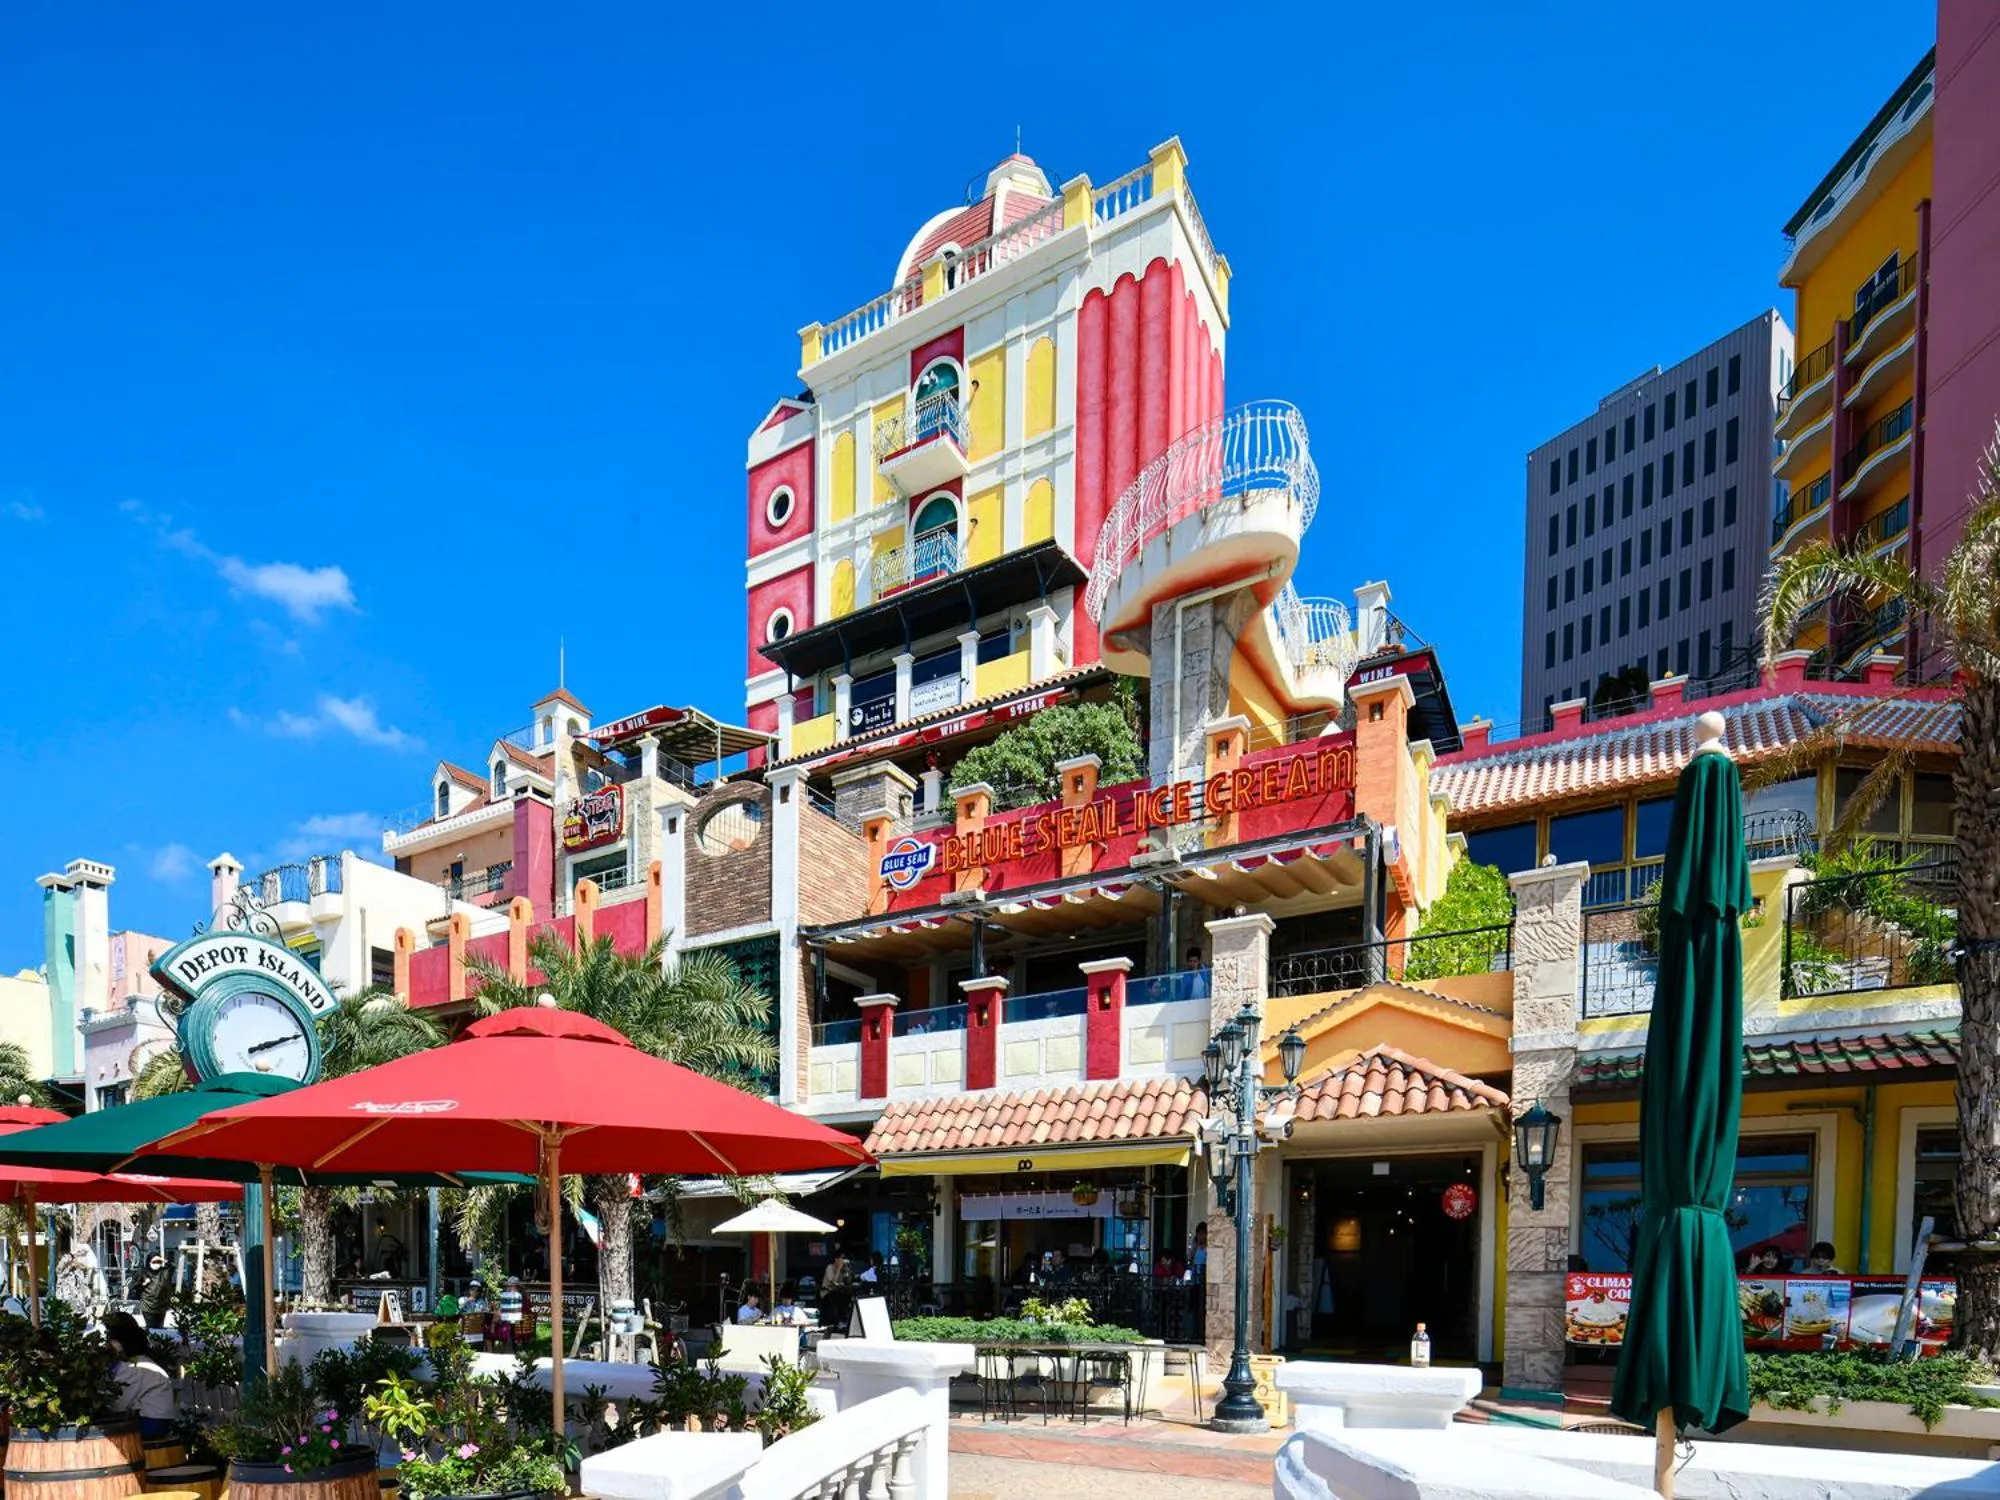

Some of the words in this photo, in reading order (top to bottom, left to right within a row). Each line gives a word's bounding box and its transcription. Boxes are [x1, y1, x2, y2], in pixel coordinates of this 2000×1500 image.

[1360, 666, 1394, 684] WINE
[1010, 697, 1045, 717] STEAK
[627, 714, 650, 730] WINE
[940, 719, 967, 737] WINE
[943, 822, 1025, 872] BLUE
[1036, 799, 1119, 851] SEAL
[1134, 780, 1192, 832] ICE
[1205, 747, 1356, 814] CREAM
[884, 857, 905, 871] BLUE
[906, 851, 927, 866] SEAL
[178, 946, 248, 983] DEPOT
[257, 947, 325, 1010] ISLAND
